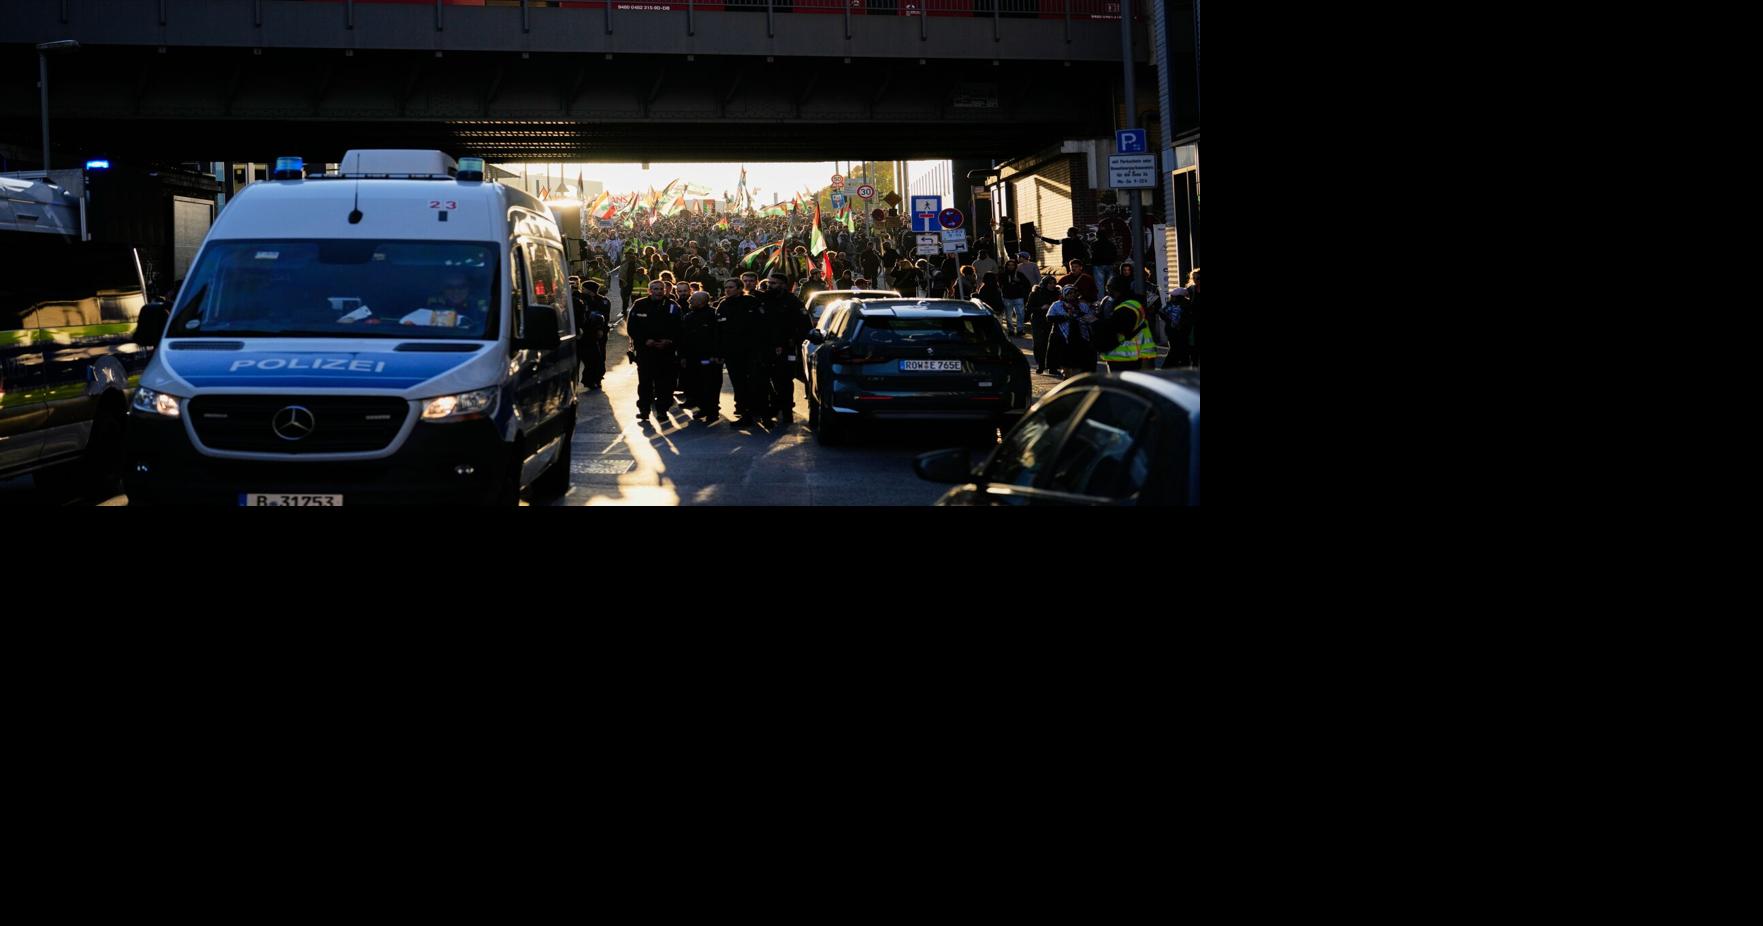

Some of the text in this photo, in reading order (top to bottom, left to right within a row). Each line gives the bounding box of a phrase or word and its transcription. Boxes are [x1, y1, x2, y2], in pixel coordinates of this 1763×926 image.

[1121, 133, 1137, 151] P
[860, 188, 871, 196] 30
[229, 358, 385, 373] POLIZEI
[905, 361, 923, 370] ROW
[938, 361, 961, 370] 765E
